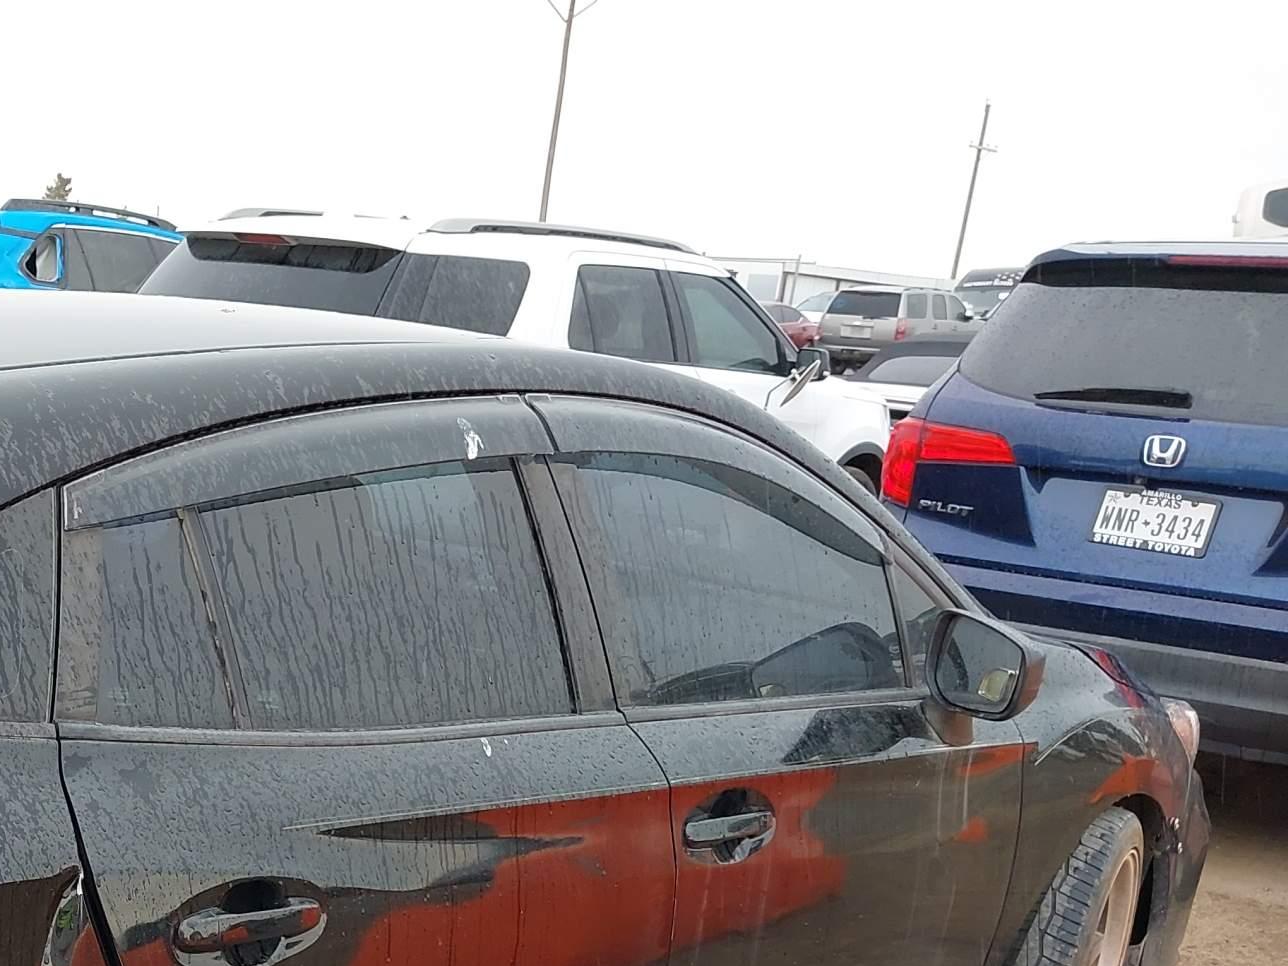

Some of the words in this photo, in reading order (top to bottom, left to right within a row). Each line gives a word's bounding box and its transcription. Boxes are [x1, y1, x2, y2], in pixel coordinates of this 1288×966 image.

[1139, 495, 1183, 510] TEXAS
[1141, 489, 1183, 501] AMARILLO
[918, 499, 974, 517] PILOT
[1093, 533, 1145, 549] STREET
[1146, 541, 1196, 557] TOYOTA
